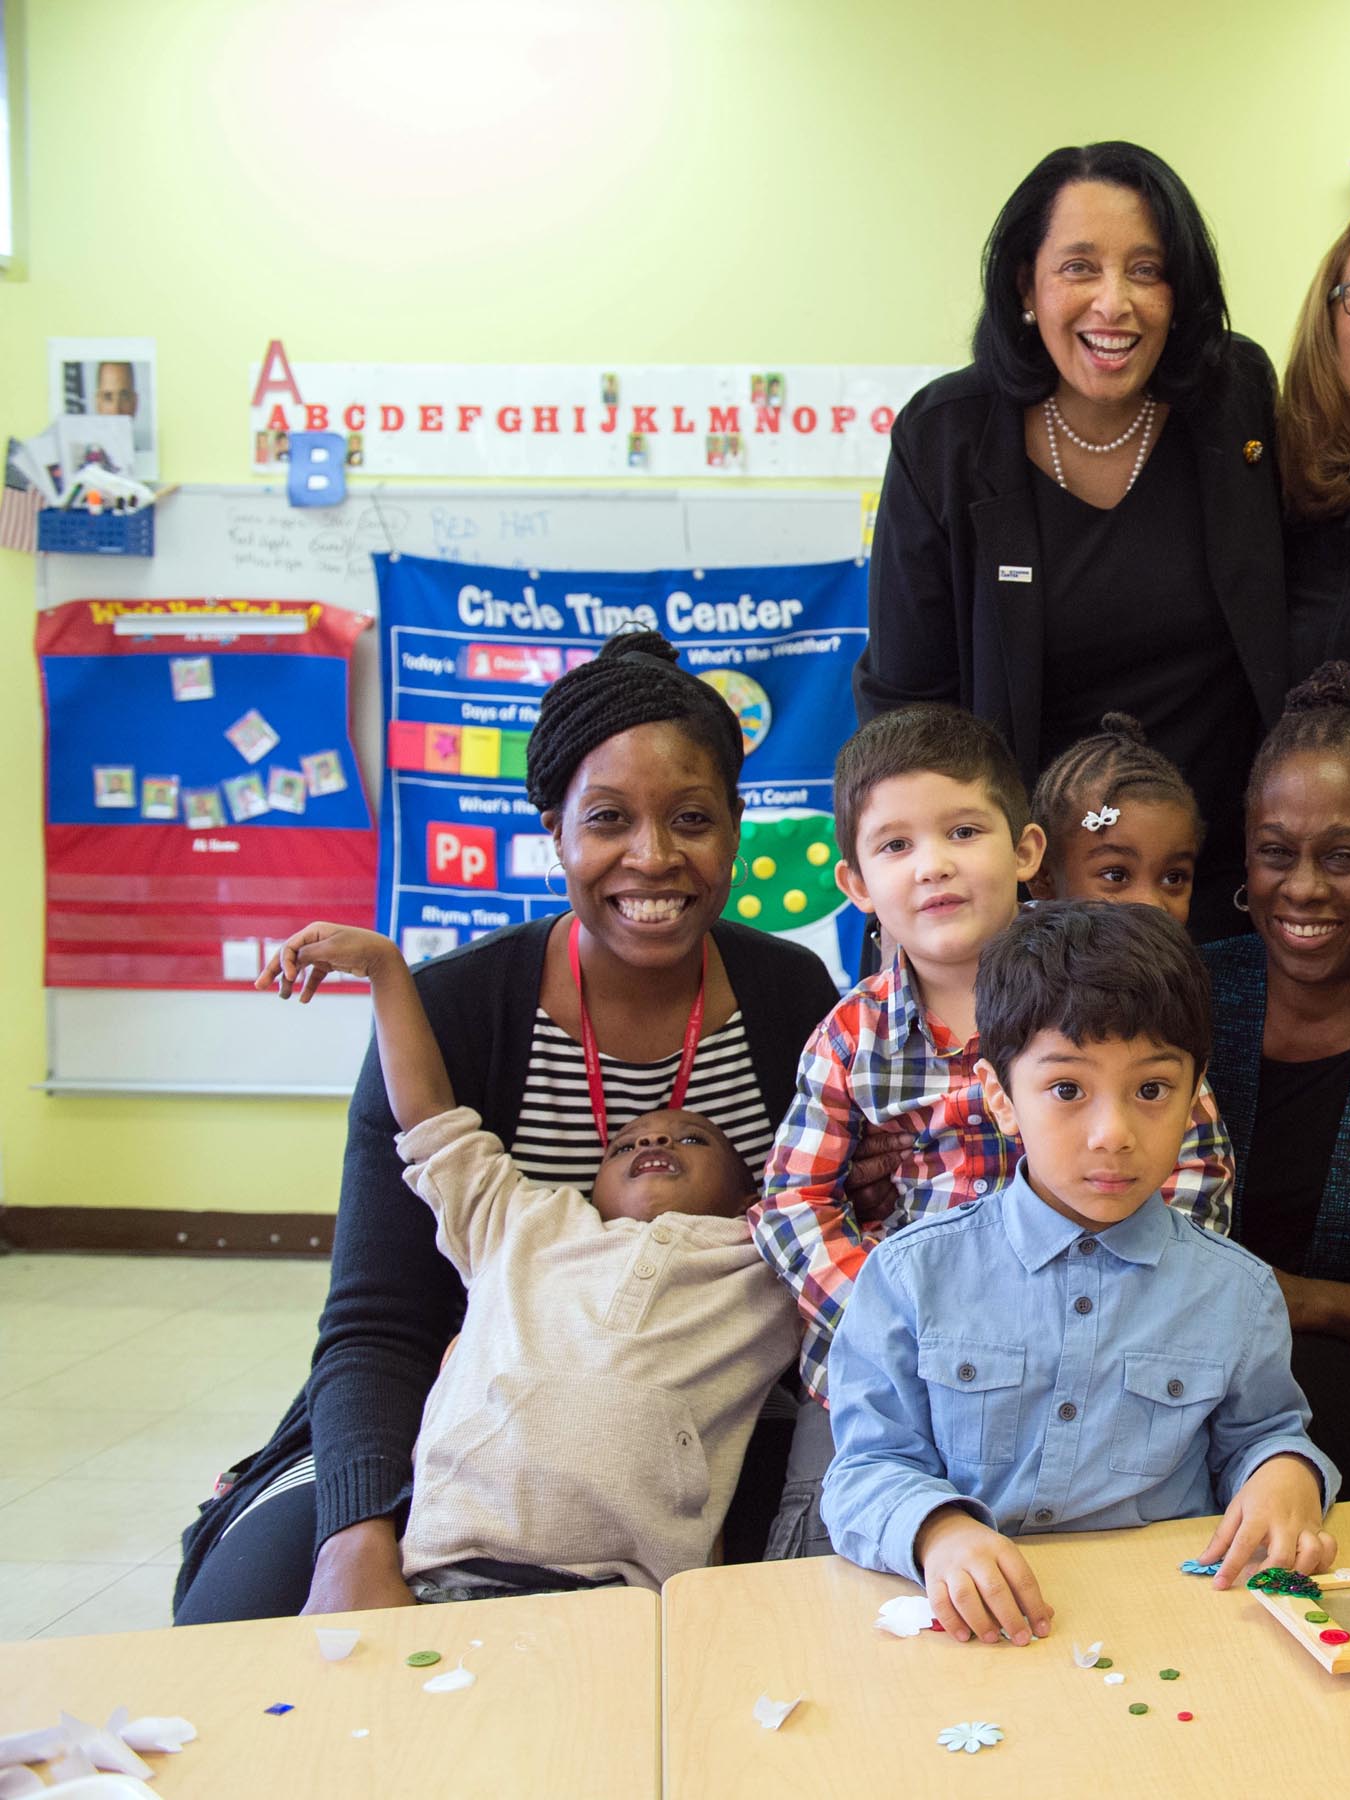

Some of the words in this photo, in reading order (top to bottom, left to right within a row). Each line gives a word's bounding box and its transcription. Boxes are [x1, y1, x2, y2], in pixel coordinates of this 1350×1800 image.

[252, 340, 303, 406] A
[287, 432, 347, 507] B
[458, 585, 563, 630] Circle
[565, 593, 658, 634] Time
[667, 591, 802, 632] Center
[402, 652, 455, 675] Today's
[687, 647, 743, 665] What's
[745, 646, 770, 662] the
[772, 636, 841, 657] weather?
[462, 703, 497, 723] Days
[500, 704, 517, 720] of
[459, 796, 511, 814] What's
[763, 788, 808, 805] Count
[435, 832, 486, 882] Pp
[422, 905, 470, 925] Rhyme
[472, 909, 510, 925] Time
